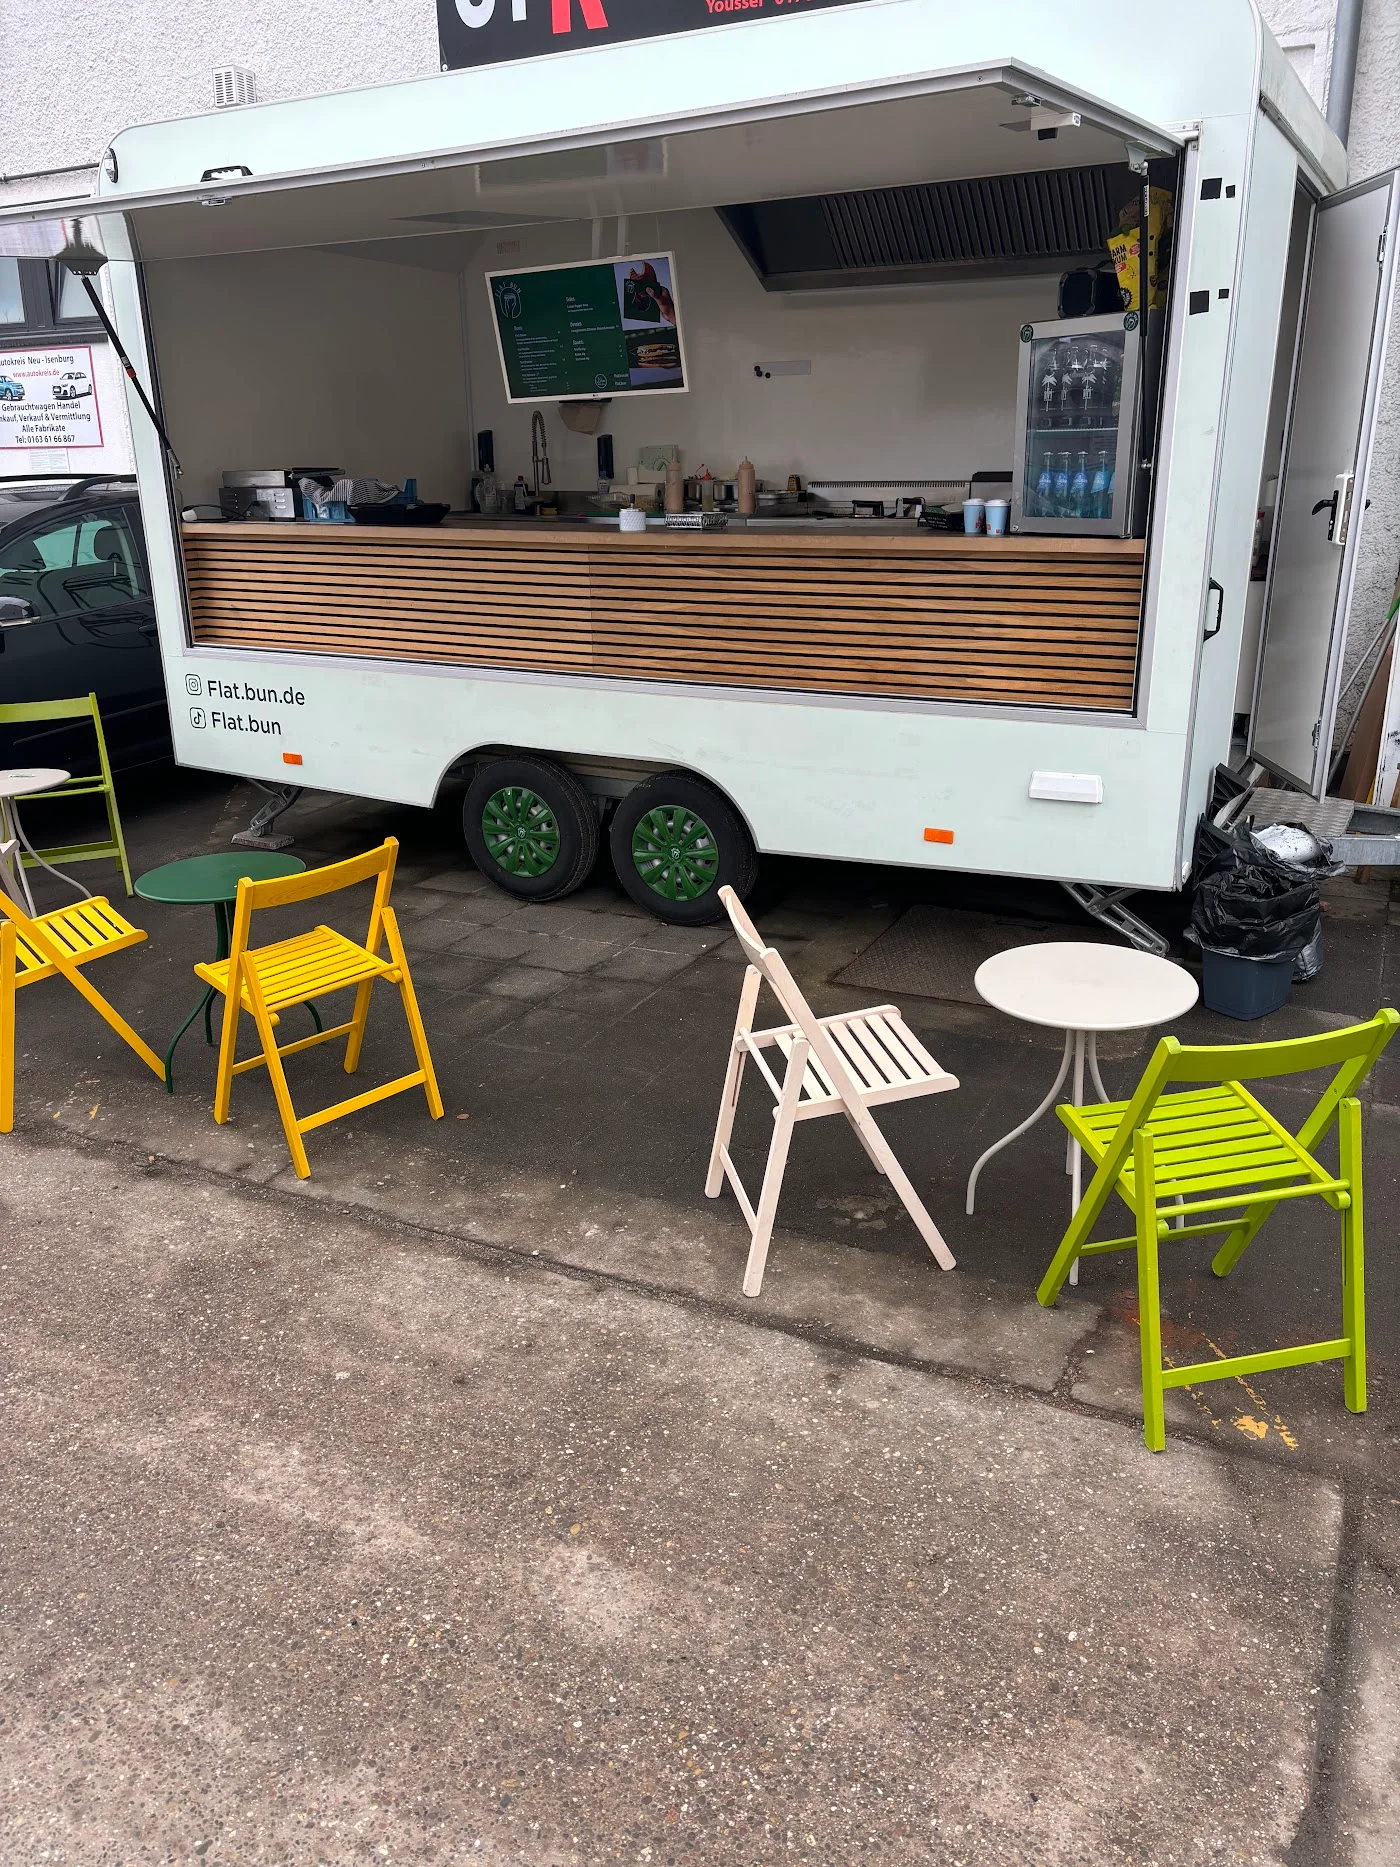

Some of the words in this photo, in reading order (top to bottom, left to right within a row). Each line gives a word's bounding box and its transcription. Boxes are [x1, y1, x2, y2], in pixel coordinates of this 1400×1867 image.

[0, 356, 26, 366] utokreis
[28, 356, 41, 364] Neu
[45, 355, 74, 364] Isenburg
[13, 369, 60, 378] www.autokreis.de
[2, 402, 56, 412] Gebrauchtwagen
[56, 401, 81, 410] Handel
[19, 413, 44, 422] Verkauf
[44, 413, 50, 421] &
[50, 412, 91, 421] Vermittlung
[22, 424, 34, 433] Alle
[35, 424, 66, 433] Fabrikate
[15, 435, 27, 444] Tel:
[27, 435, 43, 443] 0163
[44, 435, 52, 443] 61
[53, 435, 62, 443] 66
[62, 434, 76, 443] 867
[207, 680, 306, 706] Flat.bun.de
[211, 711, 282, 735] Flat.bun
